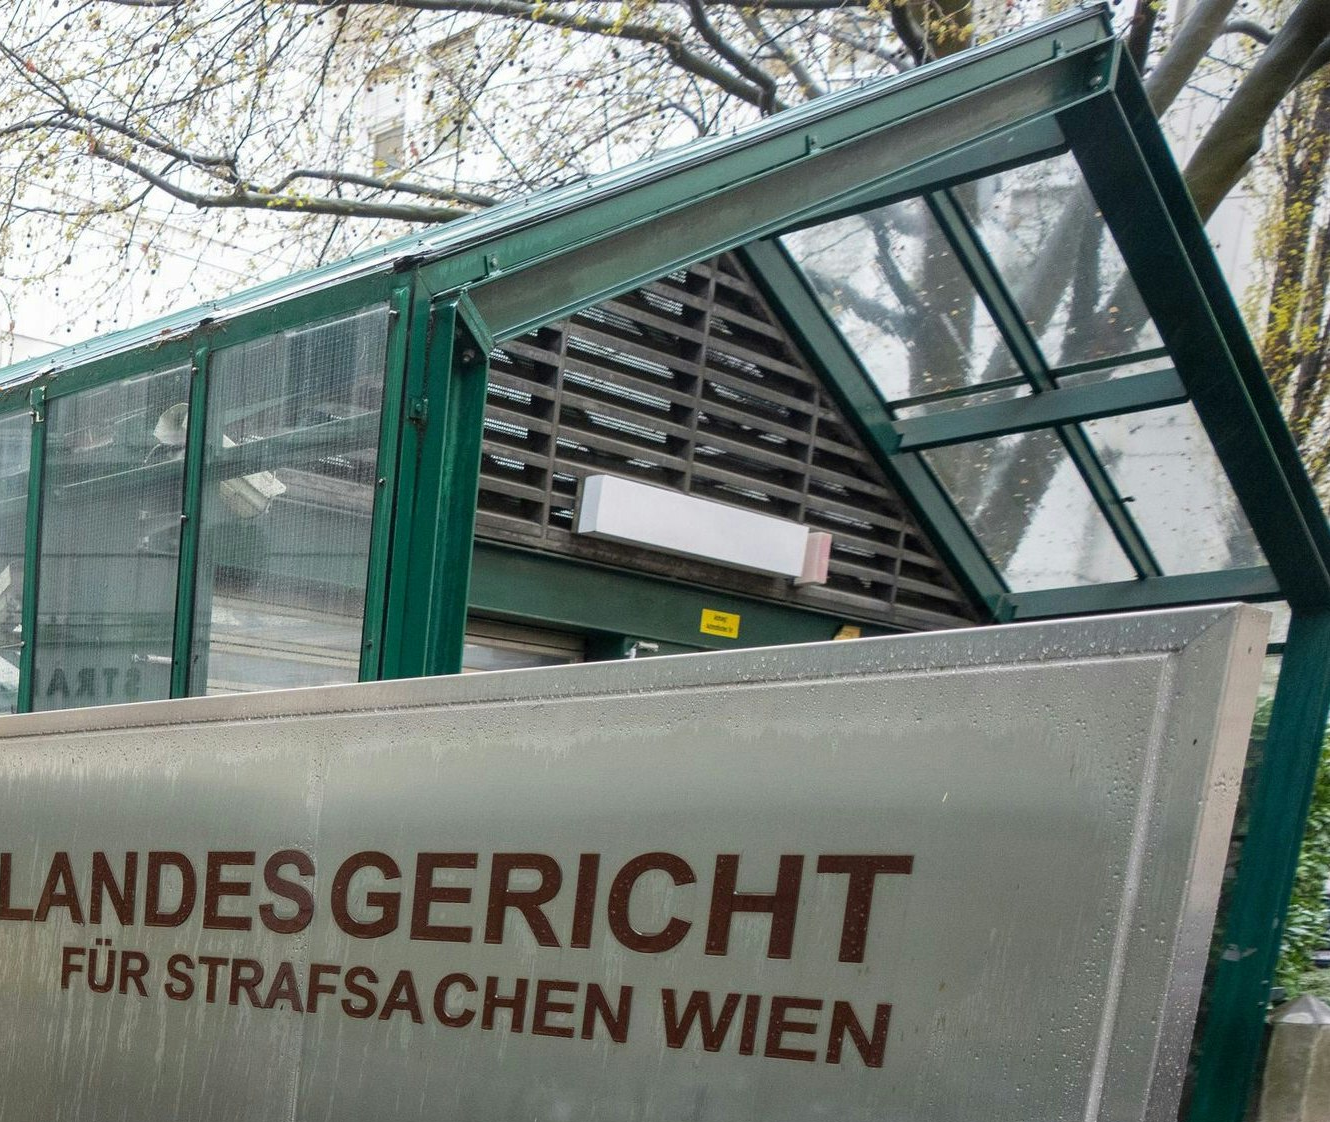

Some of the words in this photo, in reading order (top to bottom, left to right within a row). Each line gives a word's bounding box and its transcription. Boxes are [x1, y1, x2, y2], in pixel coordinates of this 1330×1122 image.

[60, 938, 149, 998] FÜR
[162, 953, 633, 1044] STRAFSACHEN
[661, 988, 893, 1068] WIEN
